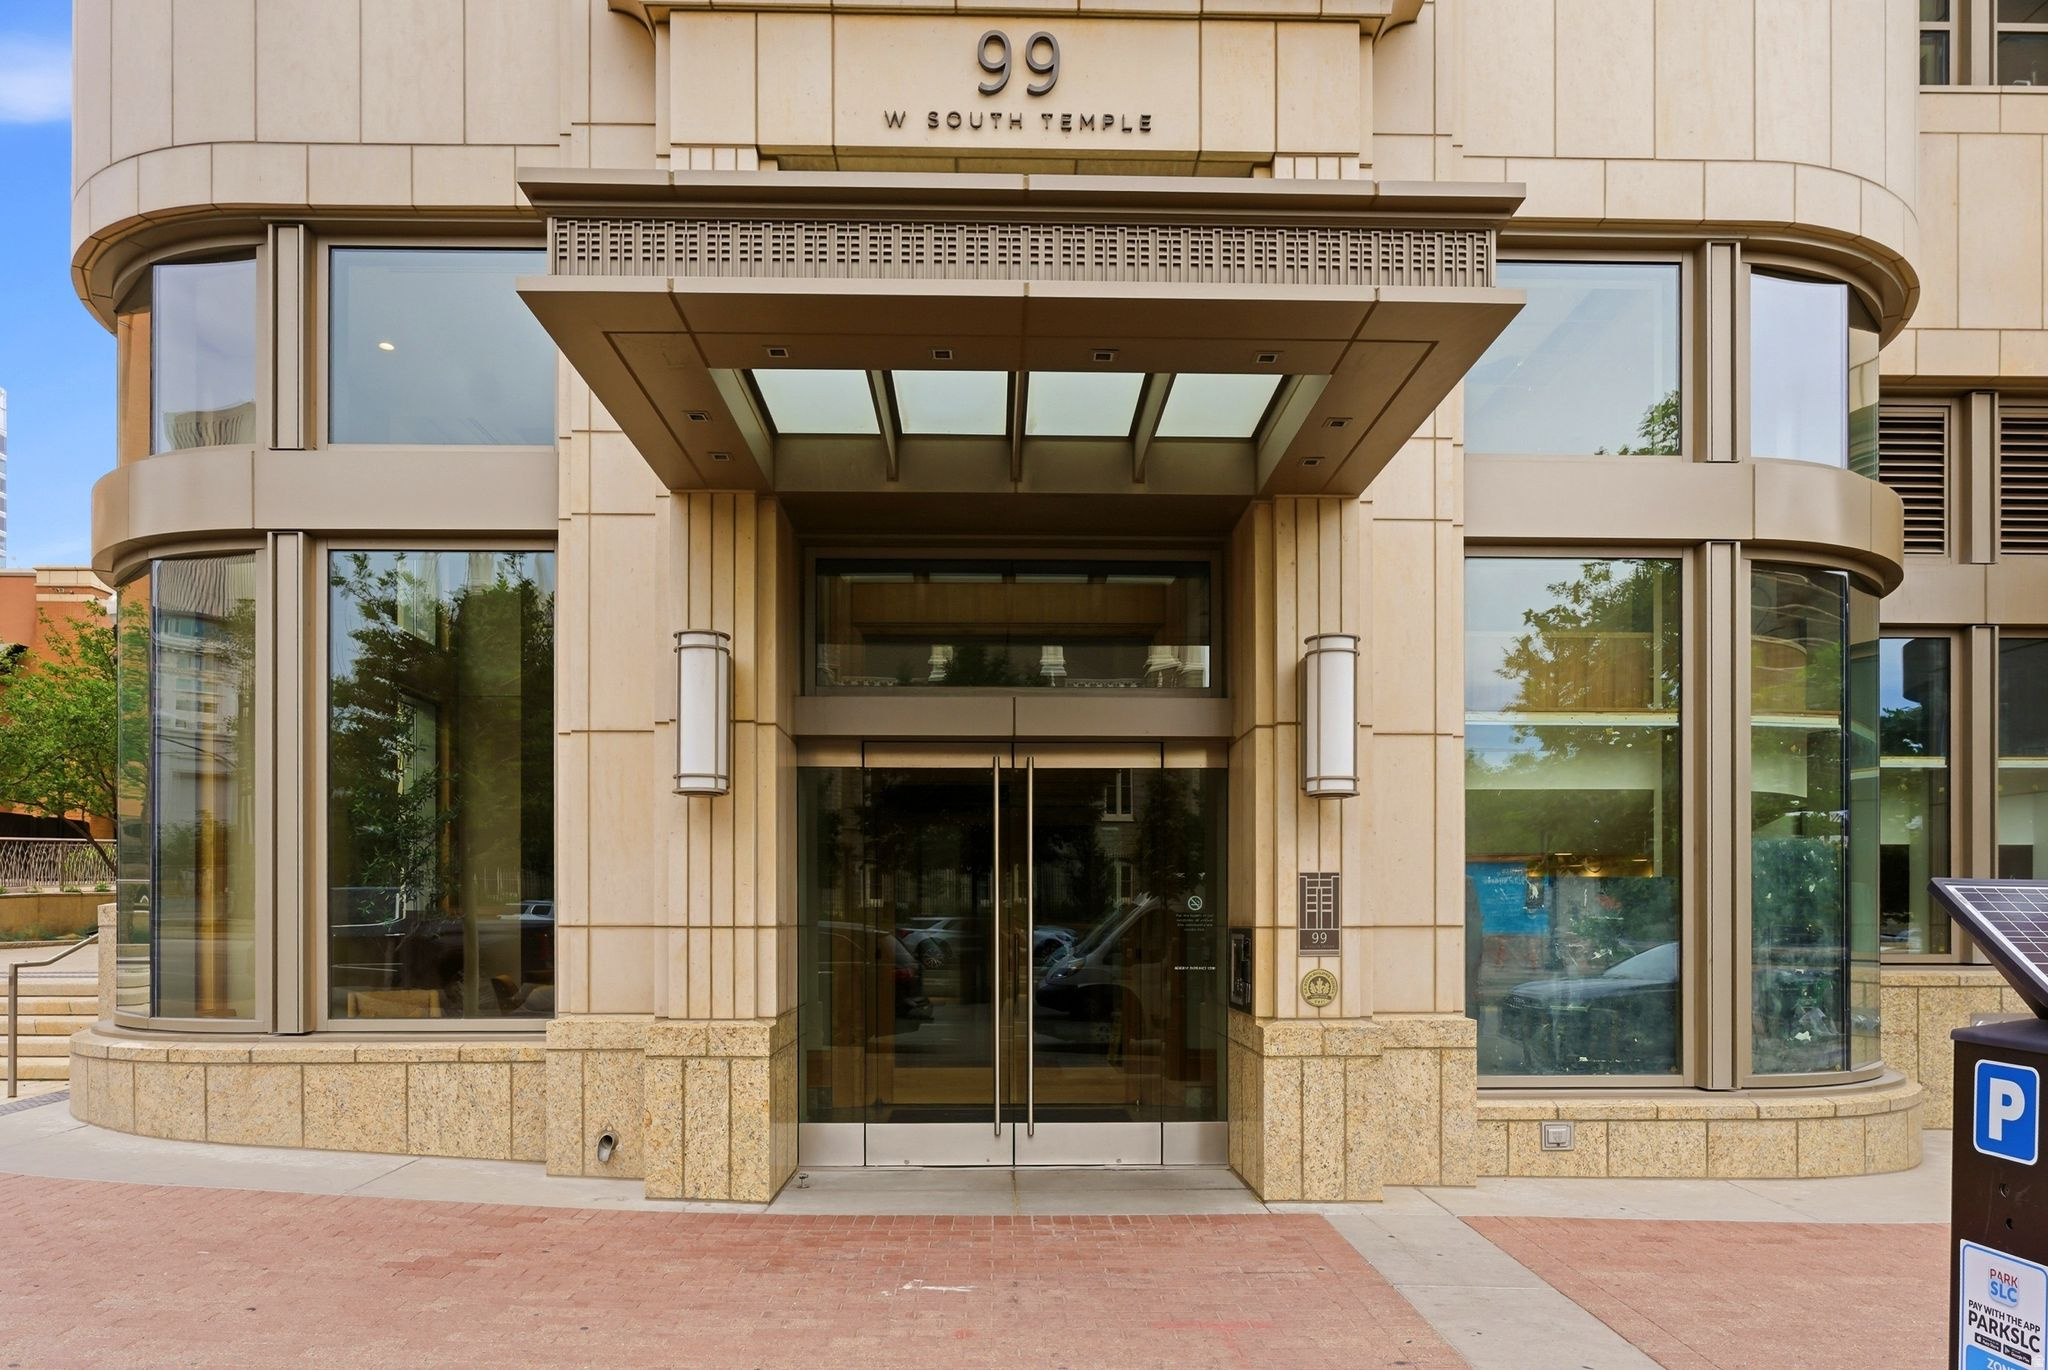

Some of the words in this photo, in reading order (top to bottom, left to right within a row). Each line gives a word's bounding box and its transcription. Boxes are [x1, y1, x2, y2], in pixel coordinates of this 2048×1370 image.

[977, 29, 1061, 96] 99
[884, 110, 906, 129] W
[927, 111, 1023, 130] SOUTH
[1041, 113, 1152, 133] TEMPLE
[1311, 931, 1328, 944] 99
[1988, 1077, 2026, 1141] P
[1989, 1268, 2018, 1288] PARK
[1990, 1280, 2017, 1303] SLC
[1968, 1299, 1983, 1311] PAY
[1983, 1304, 2005, 1321] WITH
[2006, 1313, 2023, 1328] THE
[2023, 1321, 2041, 1334] APP
[1968, 1309, 2041, 1353] PARKSLC
[1986, 1357, 2017, 1370] ZO
